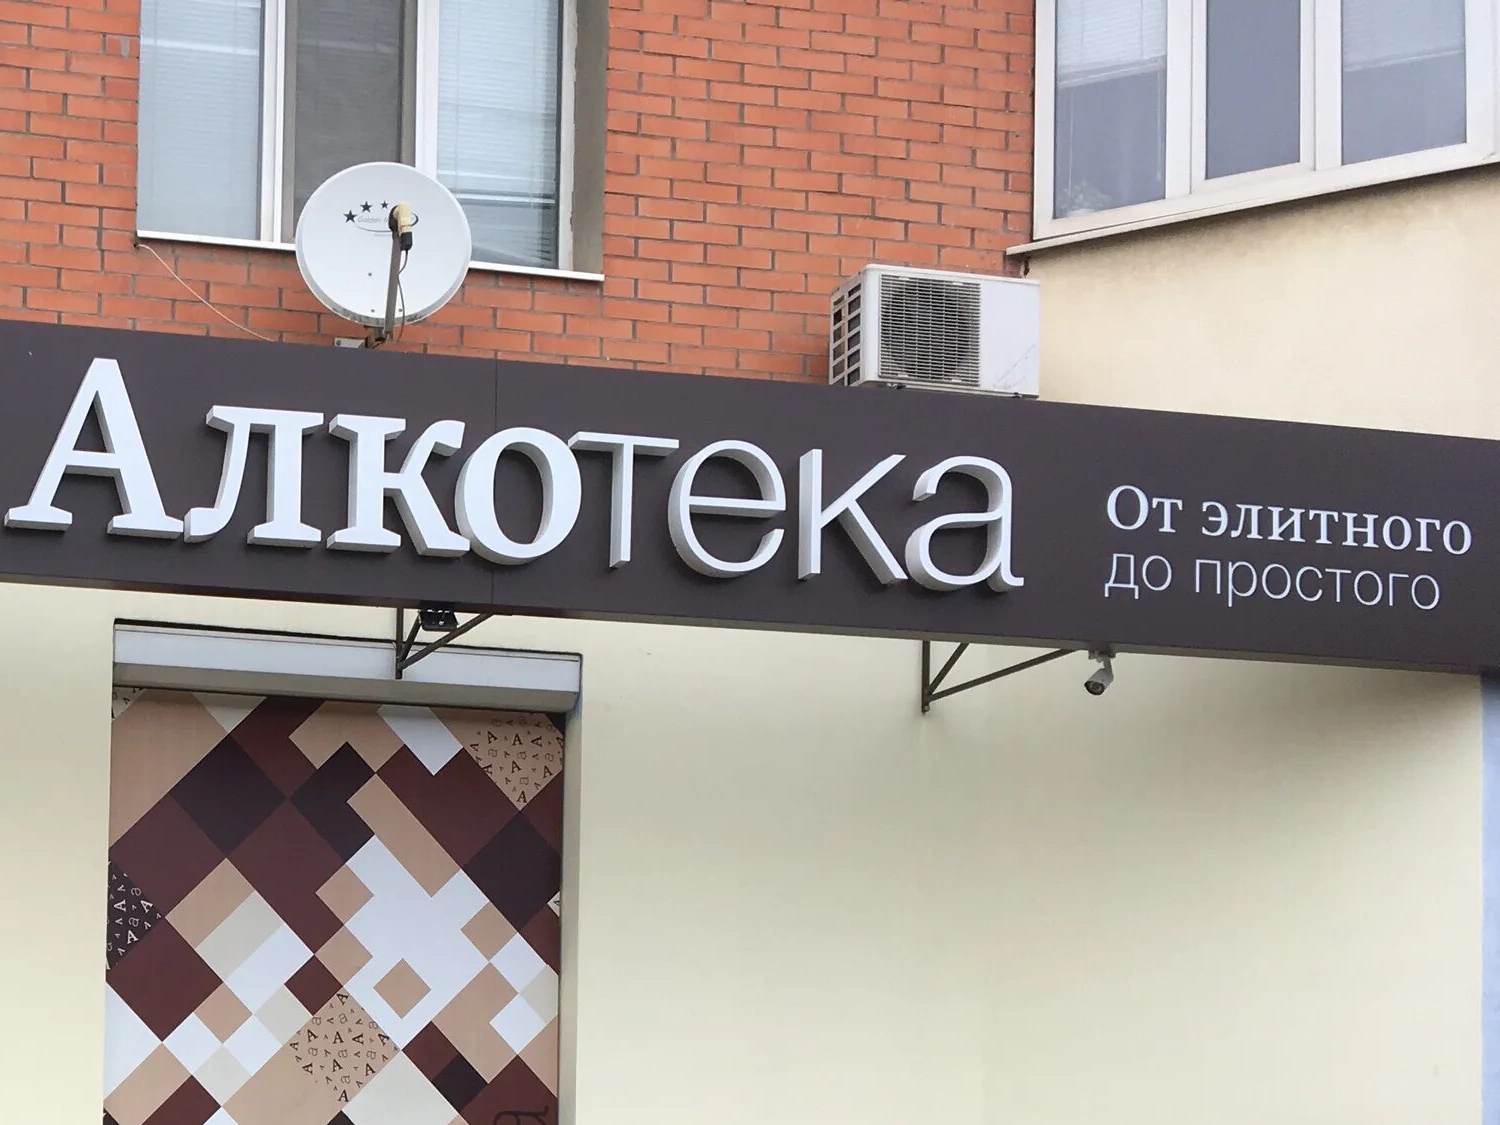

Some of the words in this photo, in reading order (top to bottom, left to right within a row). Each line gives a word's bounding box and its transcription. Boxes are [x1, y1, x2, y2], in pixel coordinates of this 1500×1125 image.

[4, 358, 1026, 592] Алкотека
[1106, 484, 1184, 534] От
[1200, 500, 1473, 556] элитного
[1104, 553, 1173, 600] до
[1194, 558, 1441, 611] простого
